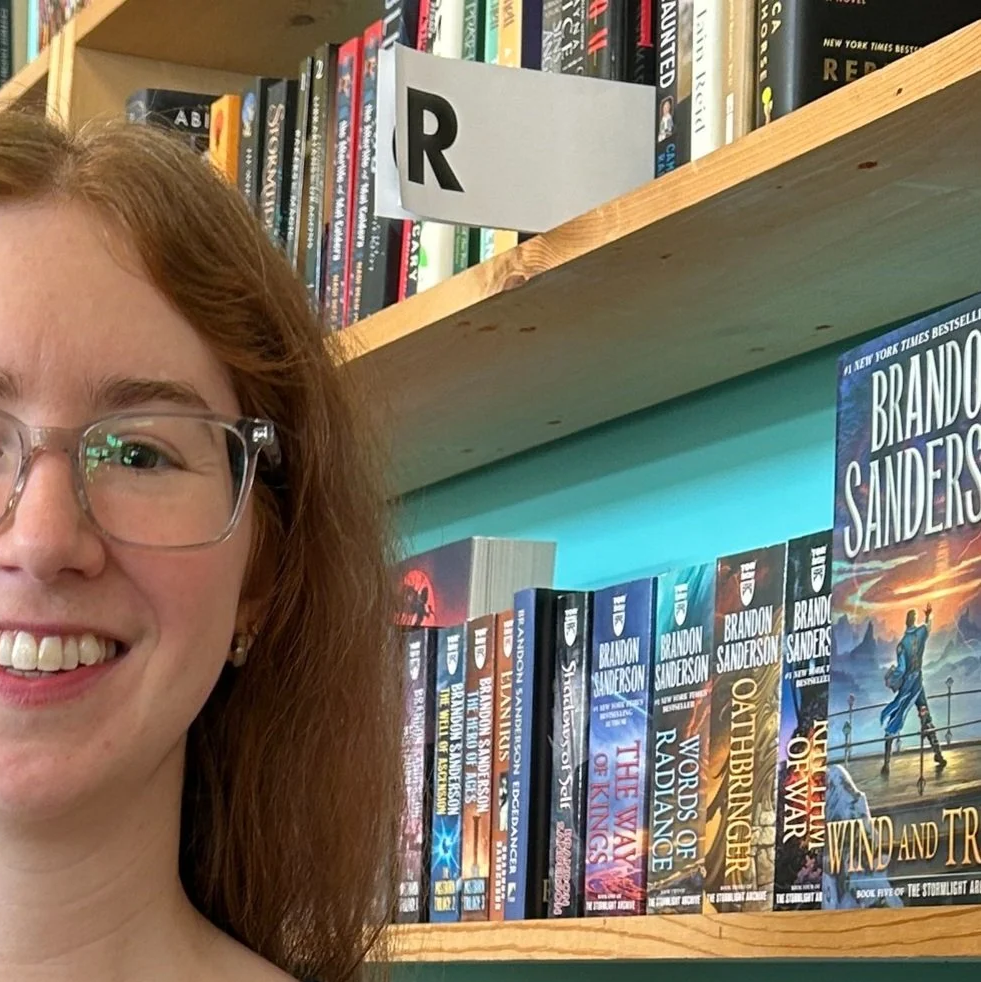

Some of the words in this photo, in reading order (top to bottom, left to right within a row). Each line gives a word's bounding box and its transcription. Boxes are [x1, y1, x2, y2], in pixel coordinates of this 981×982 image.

[659, 0, 677, 88] AUNTED
[823, 38, 842, 48] NEW
[845, 40, 868, 49] YORK
[870, 42, 893, 53] TIMES
[314, 60, 324, 78] 2
[694, 72, 706, 133] Reid
[407, 86, 465, 193] R
[853, 355, 874, 373] NEW
[875, 342, 899, 363] YORK
[900, 329, 929, 353] TIMES
[660, 626, 703, 661] BRANDON
[724, 605, 773, 642] BRANDON
[515, 609, 526, 684] BRANDON
[599, 637, 640, 669] BRANDON
[716, 635, 779, 674] SANDERSON
[592, 664, 646, 697] SANDERSON
[654, 655, 710, 691] SANDERSON
[439, 688, 450, 708] THE
[449, 683, 463, 741] BRANDON
[467, 692, 478, 715] THE
[477, 677, 492, 737] BRANDON
[560, 660, 578, 749] Shadows
[438, 711, 450, 740] WELL
[466, 716, 478, 750] HERO
[512, 688, 523, 776] SANDERSON
[438, 742, 448, 753] OF
[466, 752, 477, 767] OF
[561, 750, 572, 773] of
[593, 753, 610, 777] OF
[786, 736, 810, 777] OF
[436, 756, 448, 815] ASCENSION
[447, 743, 462, 816] SANDERSON
[465, 772, 476, 804] AGES
[475, 739, 491, 813] SANDERSON
[615, 740, 641, 800] THE
[676, 735, 700, 822] WORDS
[725, 678, 757, 877] OATHBRINGER
[559, 776, 573, 810] Self
[652, 728, 677, 872] RADIANCE
[783, 779, 810, 844] WAR
[509, 781, 521, 874] EDGEDANCER
[588, 783, 611, 865] KINGS
[613, 806, 638, 868] WAY
[676, 829, 698, 859] OF
[826, 815, 893, 876] WIND
[897, 821, 939, 862] AND
[856, 889, 876, 899] BOOK
[877, 888, 893, 898] FIVE
[907, 883, 921, 898] THE
[922, 880, 967, 897] STORMLIGHT
